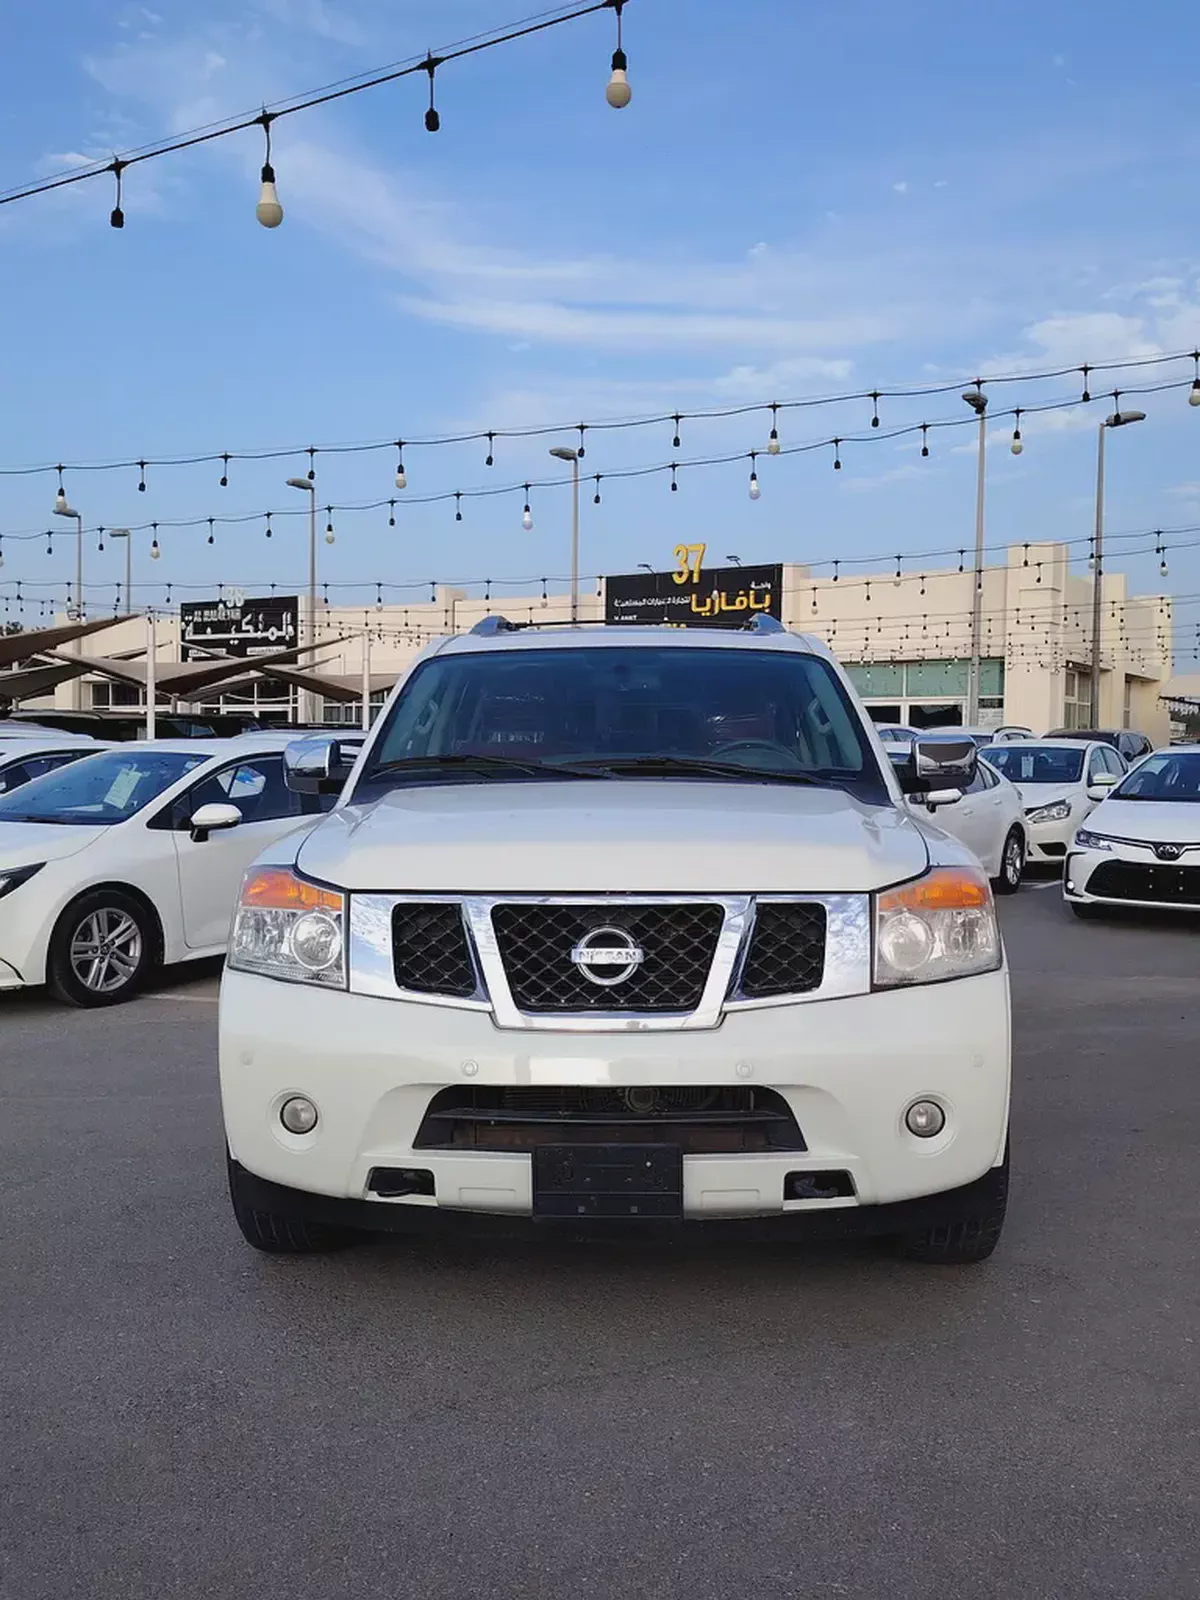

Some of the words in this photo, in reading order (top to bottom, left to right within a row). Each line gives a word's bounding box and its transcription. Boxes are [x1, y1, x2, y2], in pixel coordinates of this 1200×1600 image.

[672, 543, 707, 585] 37
[691, 589, 772, 617] بافاريا
[578, 950, 637, 962] NISSAN
